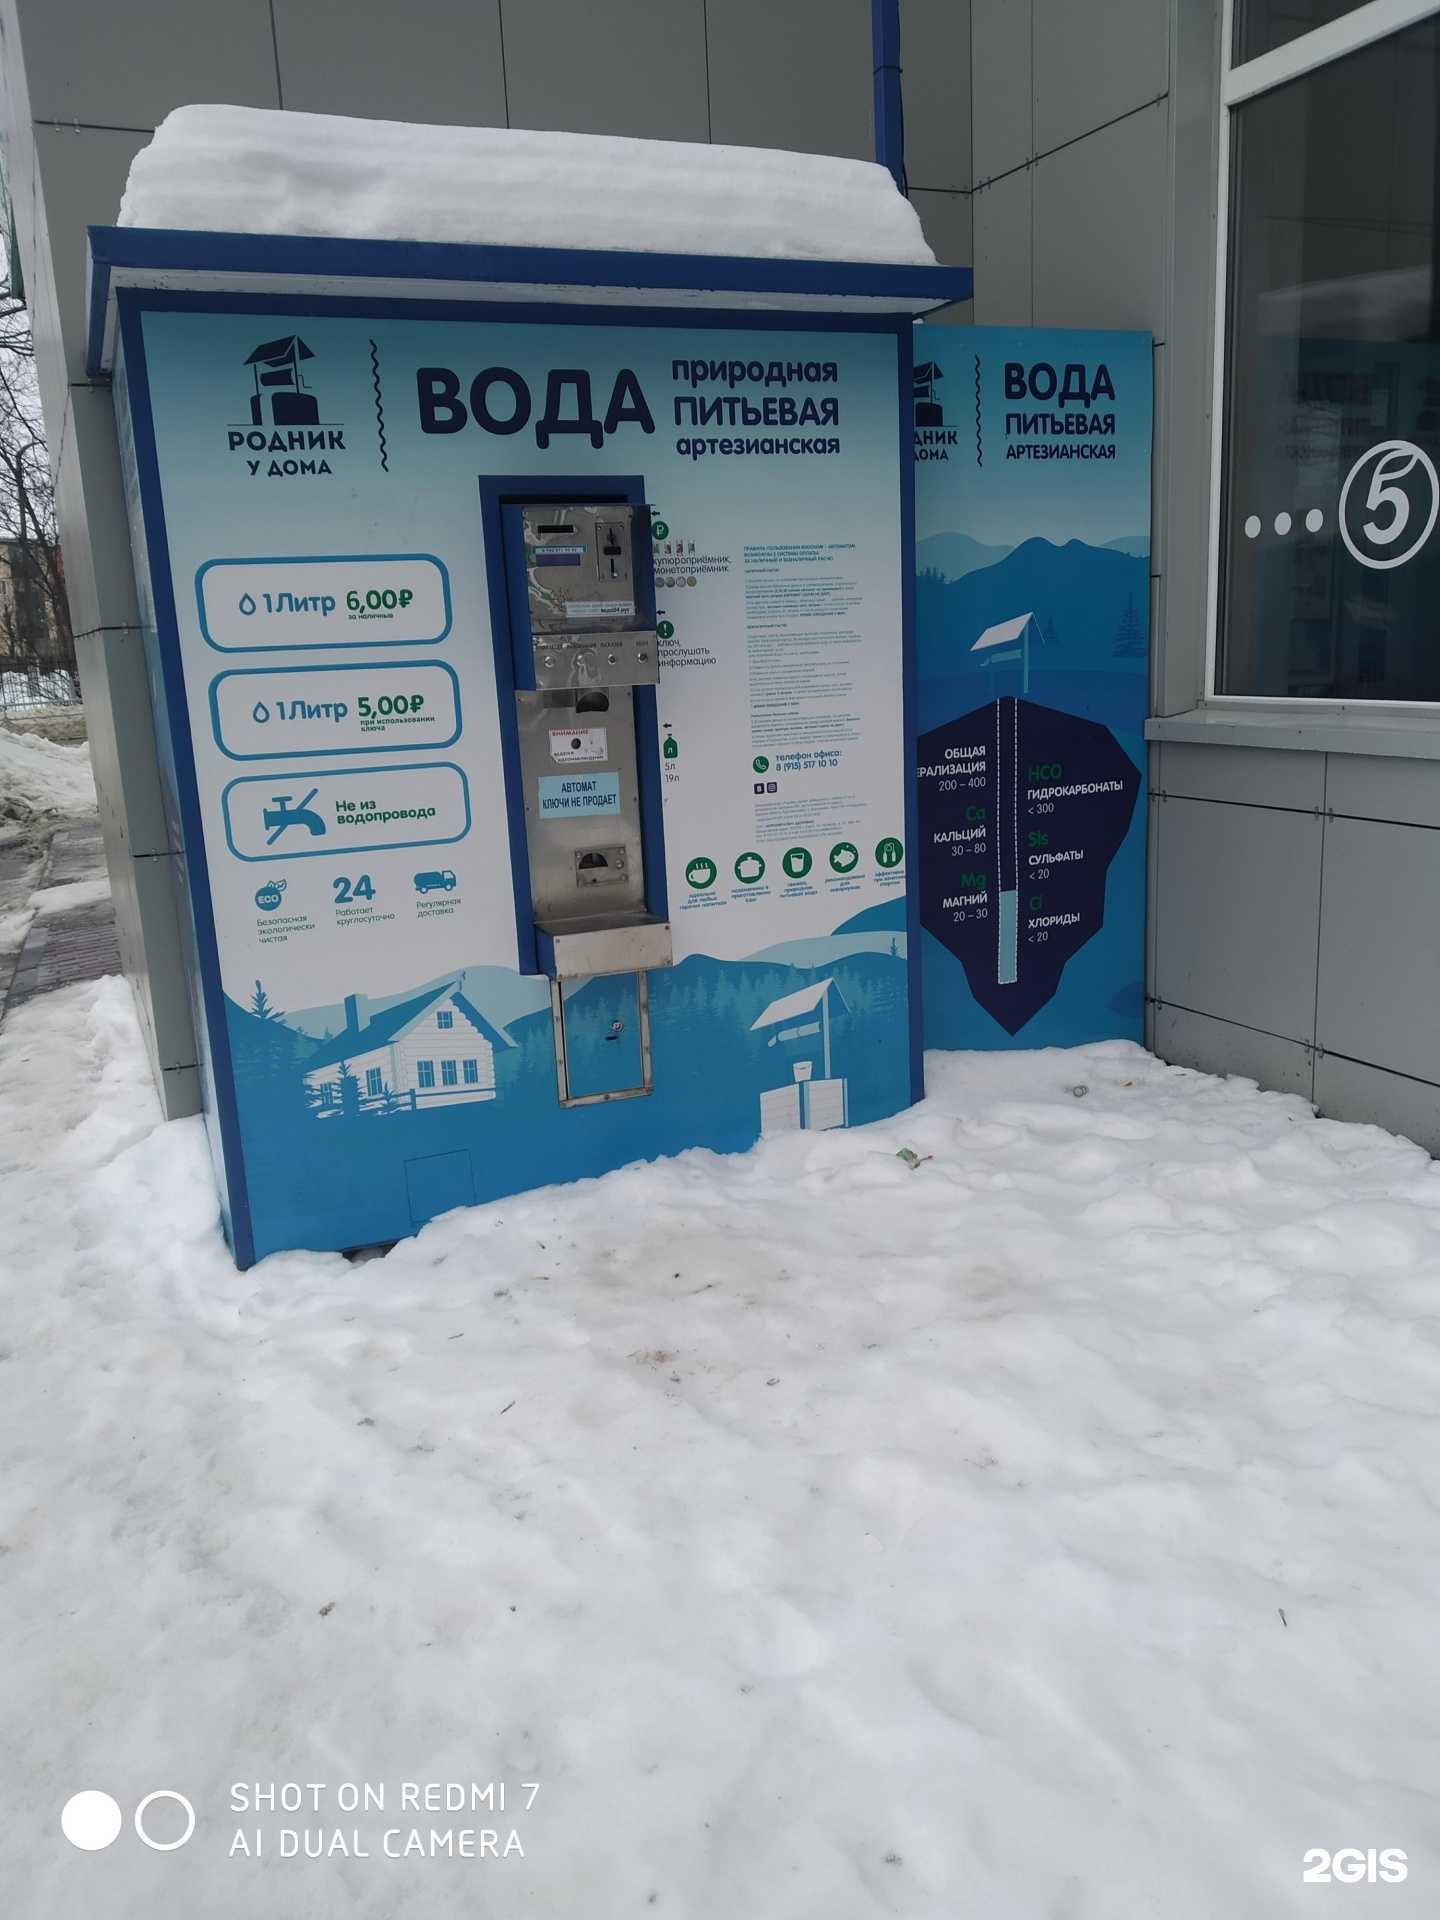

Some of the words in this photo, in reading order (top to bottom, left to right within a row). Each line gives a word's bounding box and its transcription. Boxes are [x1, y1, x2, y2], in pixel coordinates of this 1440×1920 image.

[672, 359, 838, 388] природная
[1005, 363, 1116, 408] ВОДА
[416, 366, 656, 450] ВОДА
[673, 396, 840, 426] ПИТЬЕВАЯ
[1005, 413, 1116, 435] ПИТЬЕВАЯ
[228, 431, 346, 452] РОДНИК
[676, 435, 841, 461] артезианская
[1006, 444, 1116, 460] АРТЕЗИАНСКАЯ
[247, 460, 260, 475] У
[268, 459, 332, 477] ДОМА
[360, 719, 375, 727] при
[775, 752, 811, 762] телефон
[944, 746, 986, 759] ОБЩАЯ
[776, 763, 782, 771] 8
[829, 759, 838, 767] 10
[561, 781, 597, 793] АВТОМАТ
[938, 779, 958, 792] 200
[968, 777, 986, 788] 400
[1027, 780, 1124, 801] ГИДРОКАРБОНАТЫ
[335, 801, 357, 813] Не
[360, 801, 377, 811] из
[542, 798, 571, 809] КЛЮЧИ
[571, 797, 581, 807] НЕ
[582, 794, 617, 807] ПРОДАЕТ
[1036, 803, 1055, 814] 300
[337, 806, 436, 827] водопровода
[933, 825, 986, 844] КАЛЬЦИЙ
[951, 845, 964, 857] 30
[974, 843, 987, 854] 80
[1028, 849, 1084, 866] СУЛЬФАТЫ
[1038, 868, 1050, 880] 20
[332, 875, 377, 904] 24
[416, 897, 462, 911] Регулярная
[943, 891, 988, 909] МАГНИЙ
[335, 906, 374, 916] Работает
[417, 906, 454, 918] доставка
[953, 910, 966, 922] 20
[975, 908, 988, 919] 30
[256, 914, 308, 927] Безопасная
[336, 912, 396, 927] круглосуточно
[1028, 912, 1081, 929] ХЛОРИДЫ
[258, 923, 316, 936] экологически
[258, 934, 288, 944] чистая
[1037, 932, 1049, 943] 20
